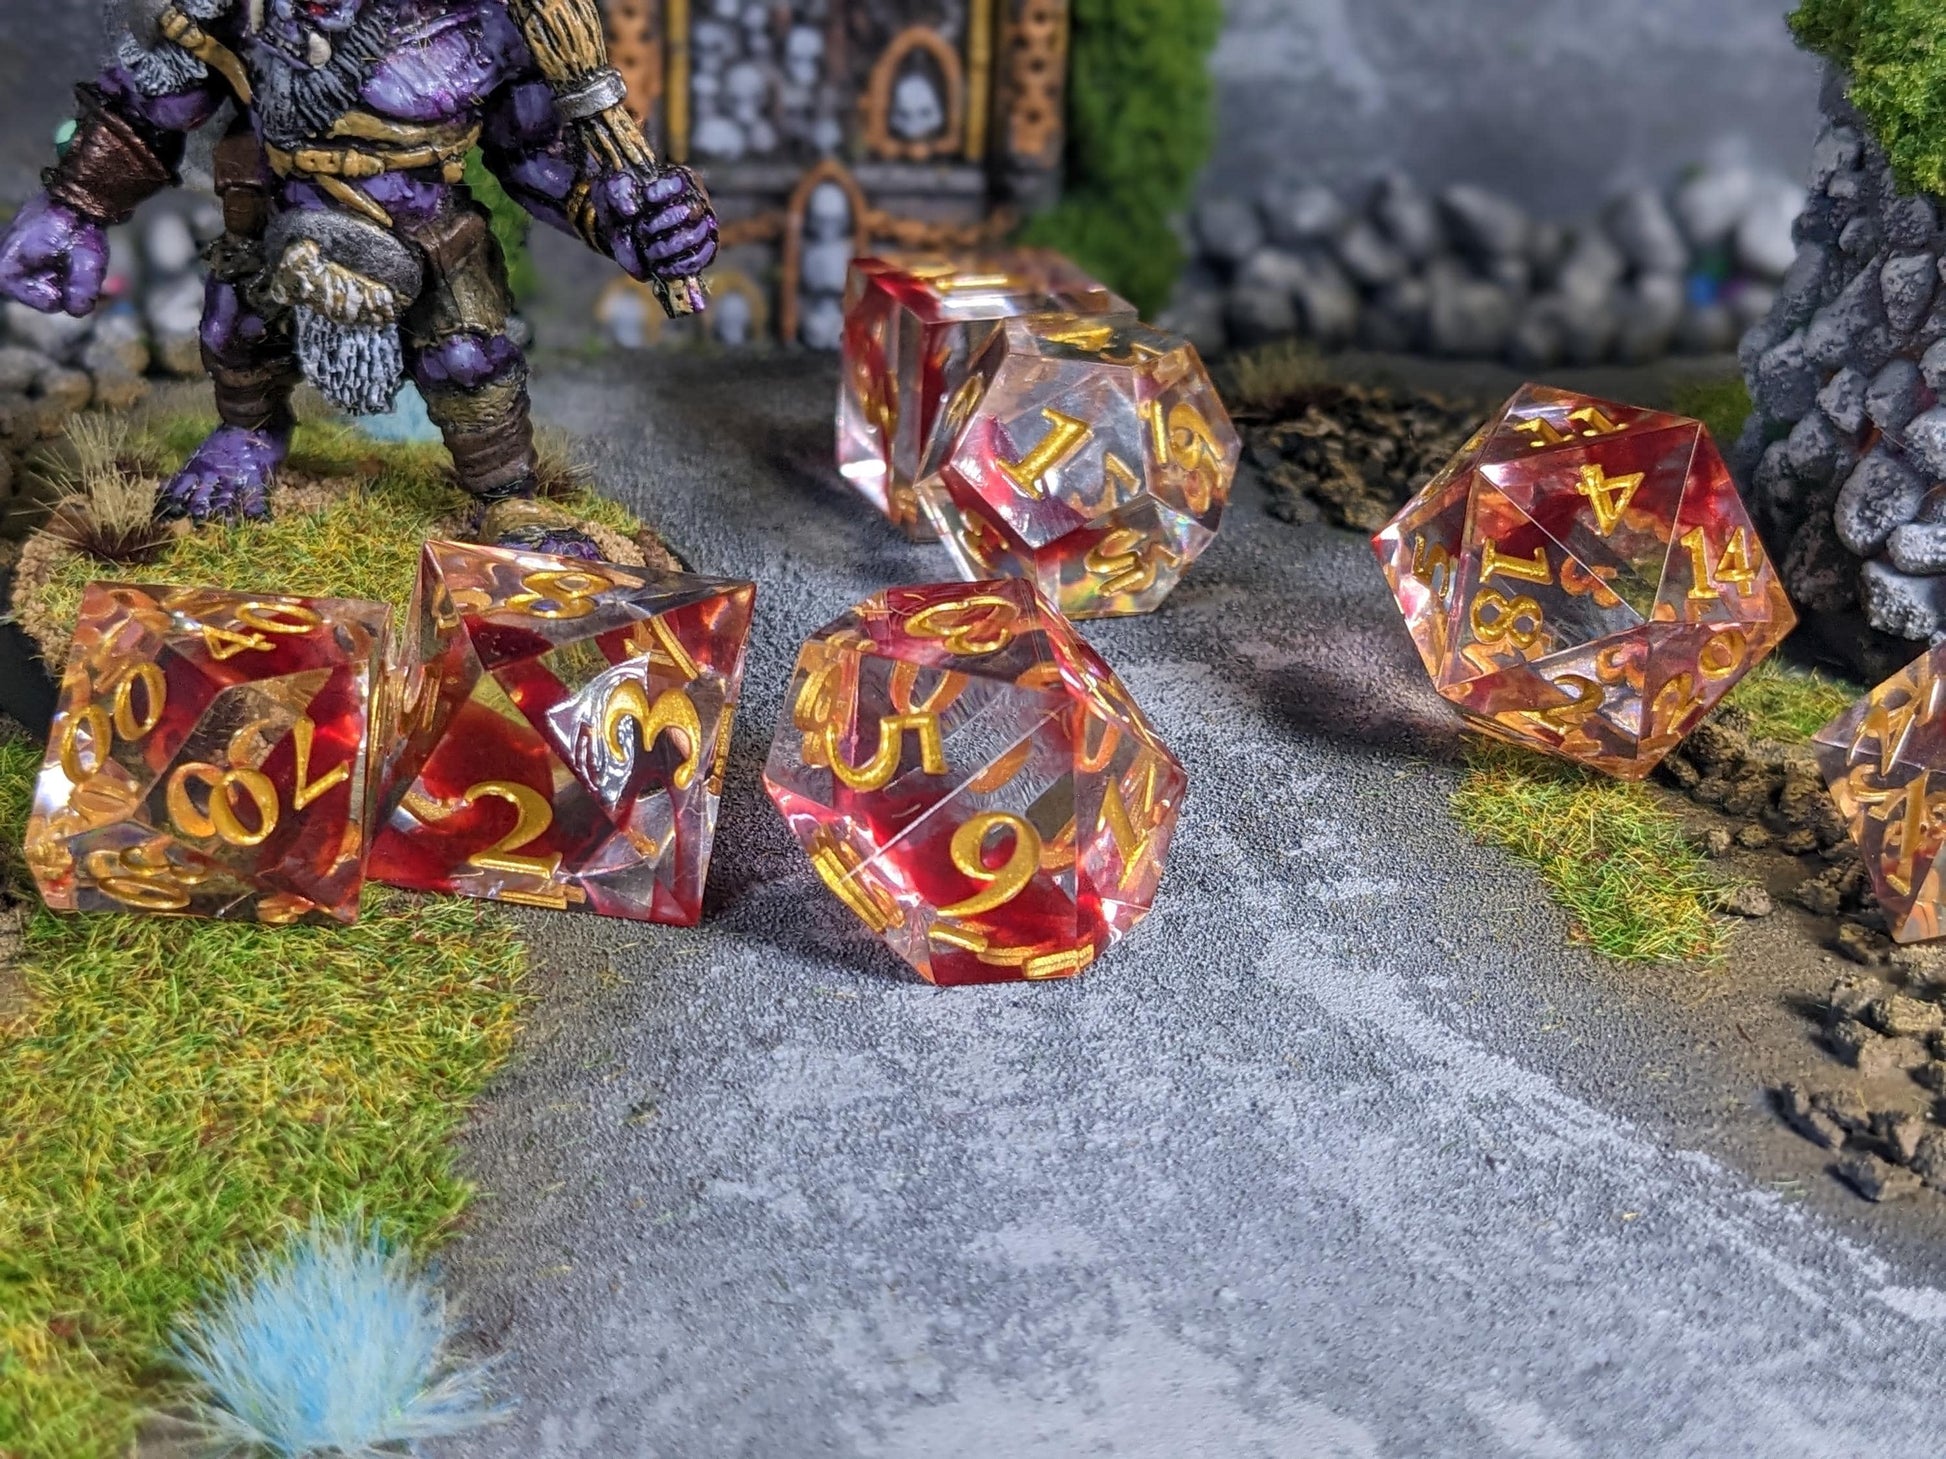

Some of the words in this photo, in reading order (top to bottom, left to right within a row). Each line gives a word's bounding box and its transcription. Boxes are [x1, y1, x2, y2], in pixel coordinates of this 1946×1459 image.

[997, 406, 1091, 500] 1
[1514, 407, 1630, 448] 11
[1575, 463, 1645, 537] 4
[505, 571, 614, 619] 8
[1680, 525, 1760, 601] 14
[60, 661, 167, 785] 00
[603, 678, 701, 790] 3
[825, 712, 948, 792] 5
[466, 780, 563, 878] 2
[935, 810, 1041, 917] 9
